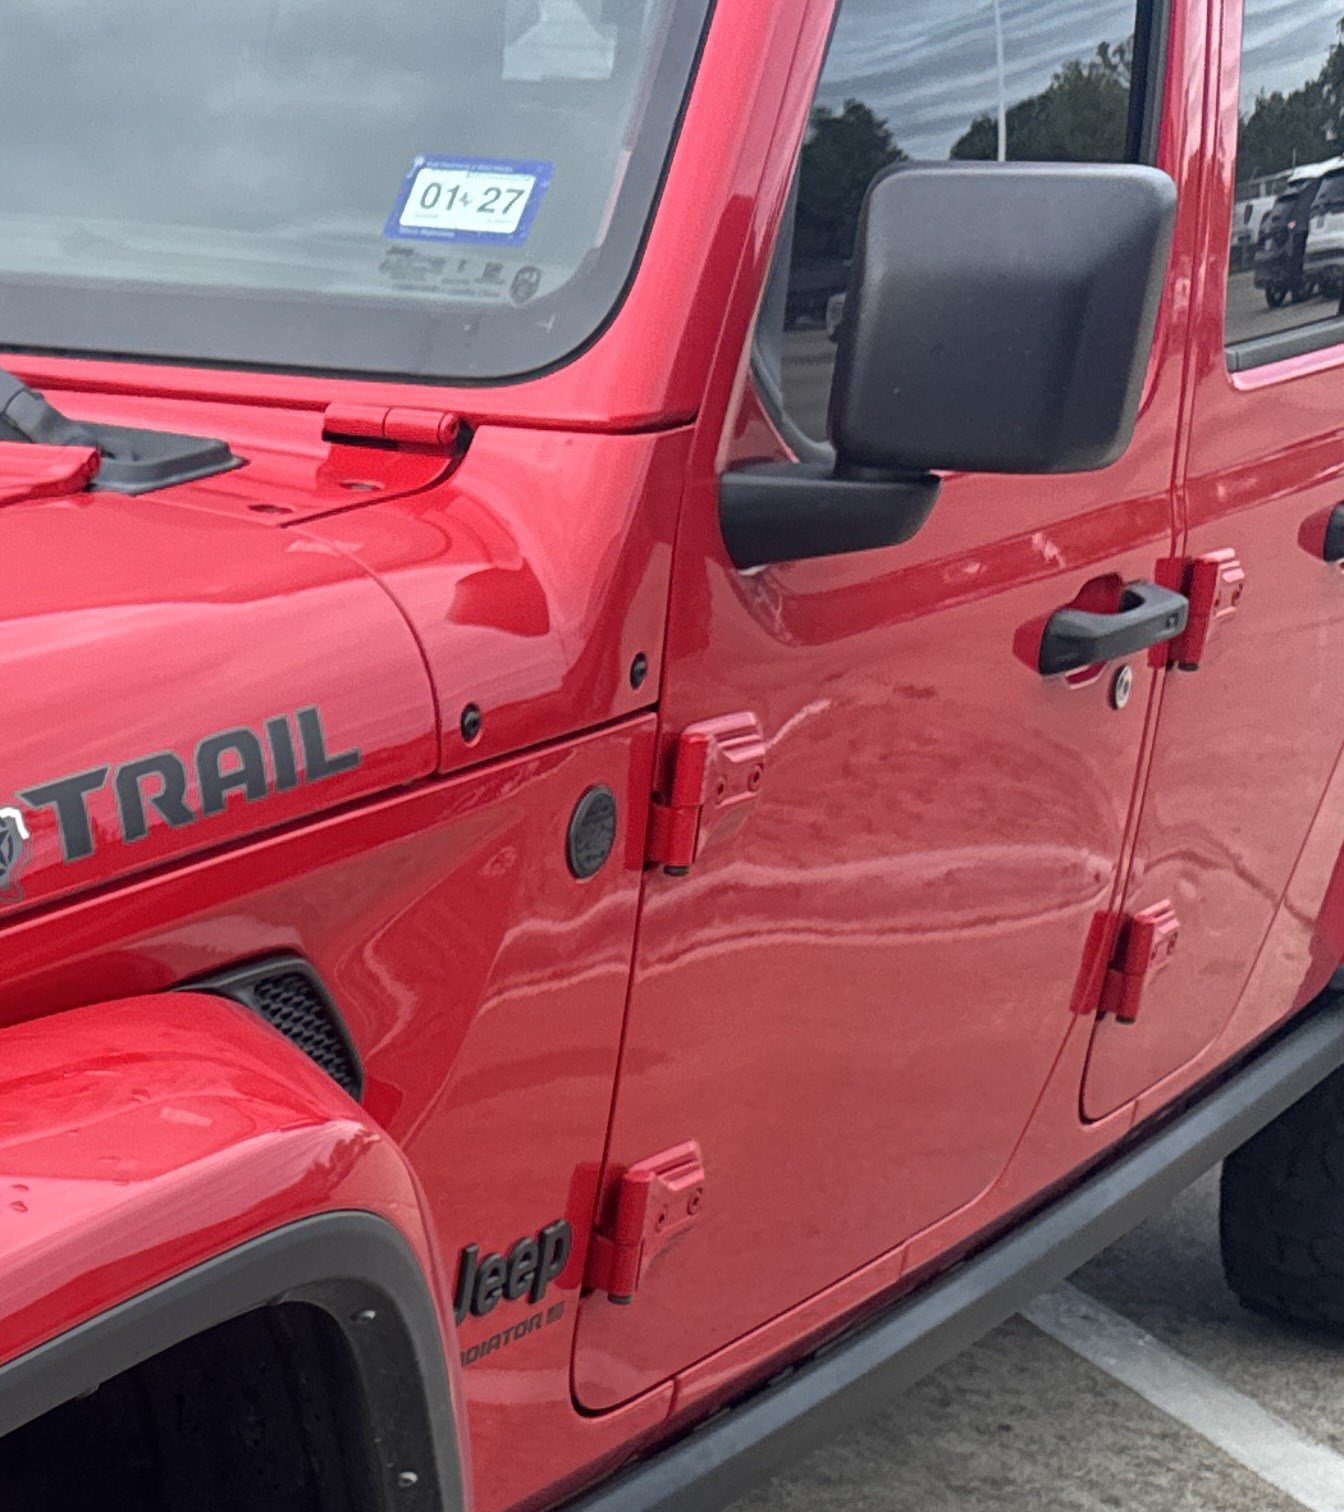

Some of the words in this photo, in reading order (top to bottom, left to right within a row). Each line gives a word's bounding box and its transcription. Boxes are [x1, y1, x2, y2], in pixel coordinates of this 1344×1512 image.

[419, 181, 460, 211] 01
[476, 186, 525, 215] 27
[18, 705, 364, 864] TRAIL
[453, 1219, 572, 1327] Jeep
